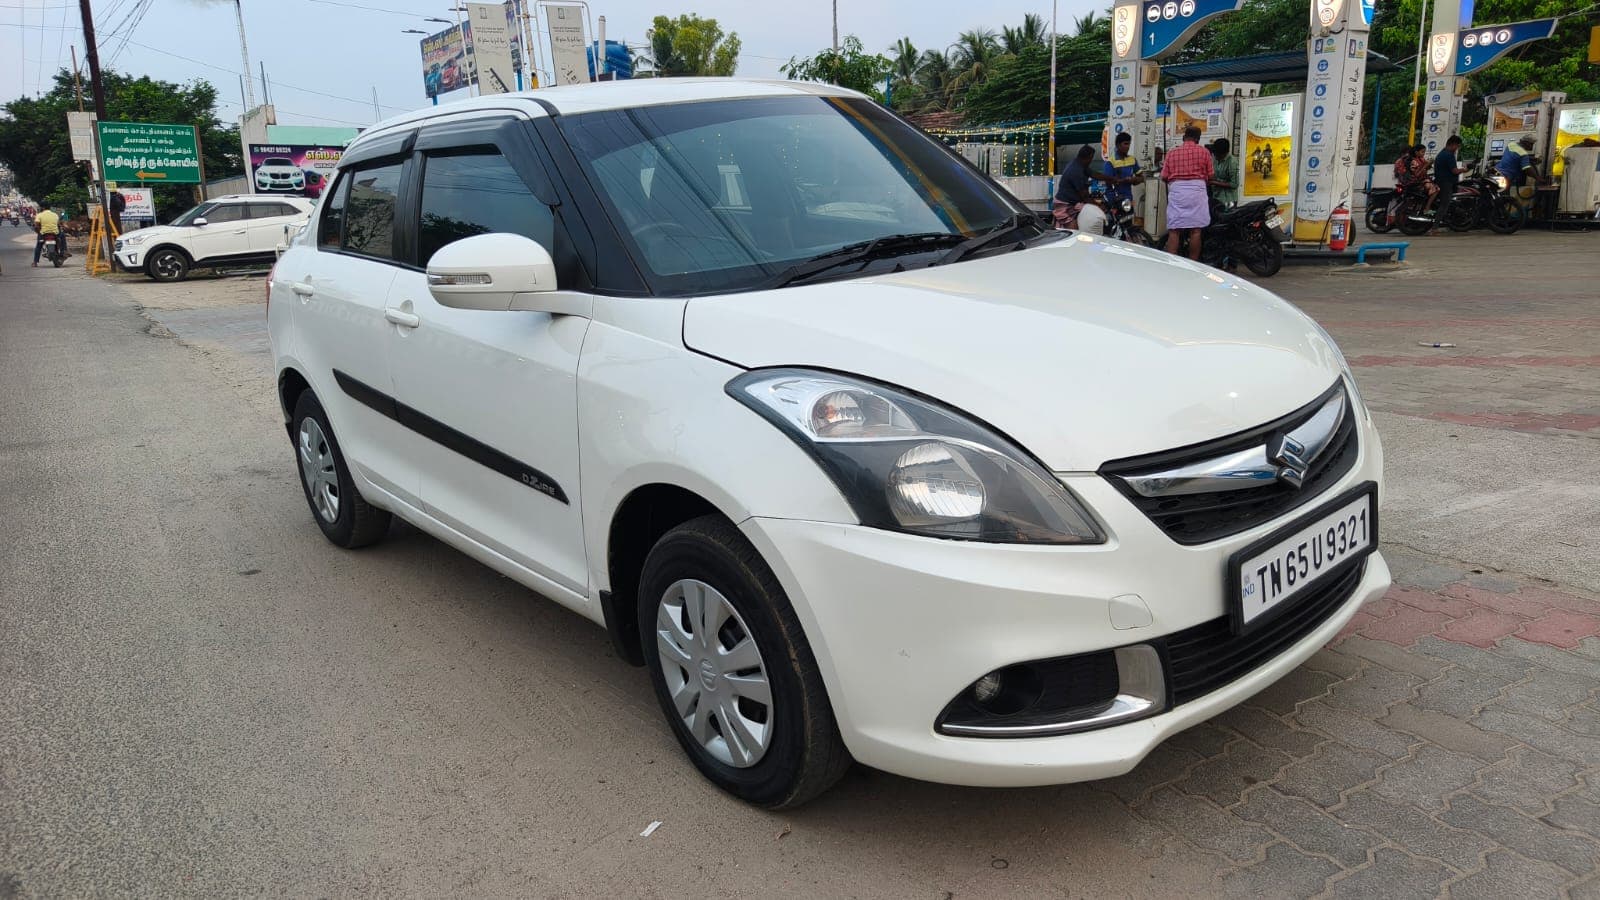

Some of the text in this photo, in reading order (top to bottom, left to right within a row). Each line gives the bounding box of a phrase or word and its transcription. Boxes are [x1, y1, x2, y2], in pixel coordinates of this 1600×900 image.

[1149, 32, 1155, 46] 1
[1464, 55, 1472, 66] 3
[1242, 584, 1254, 597] IND
